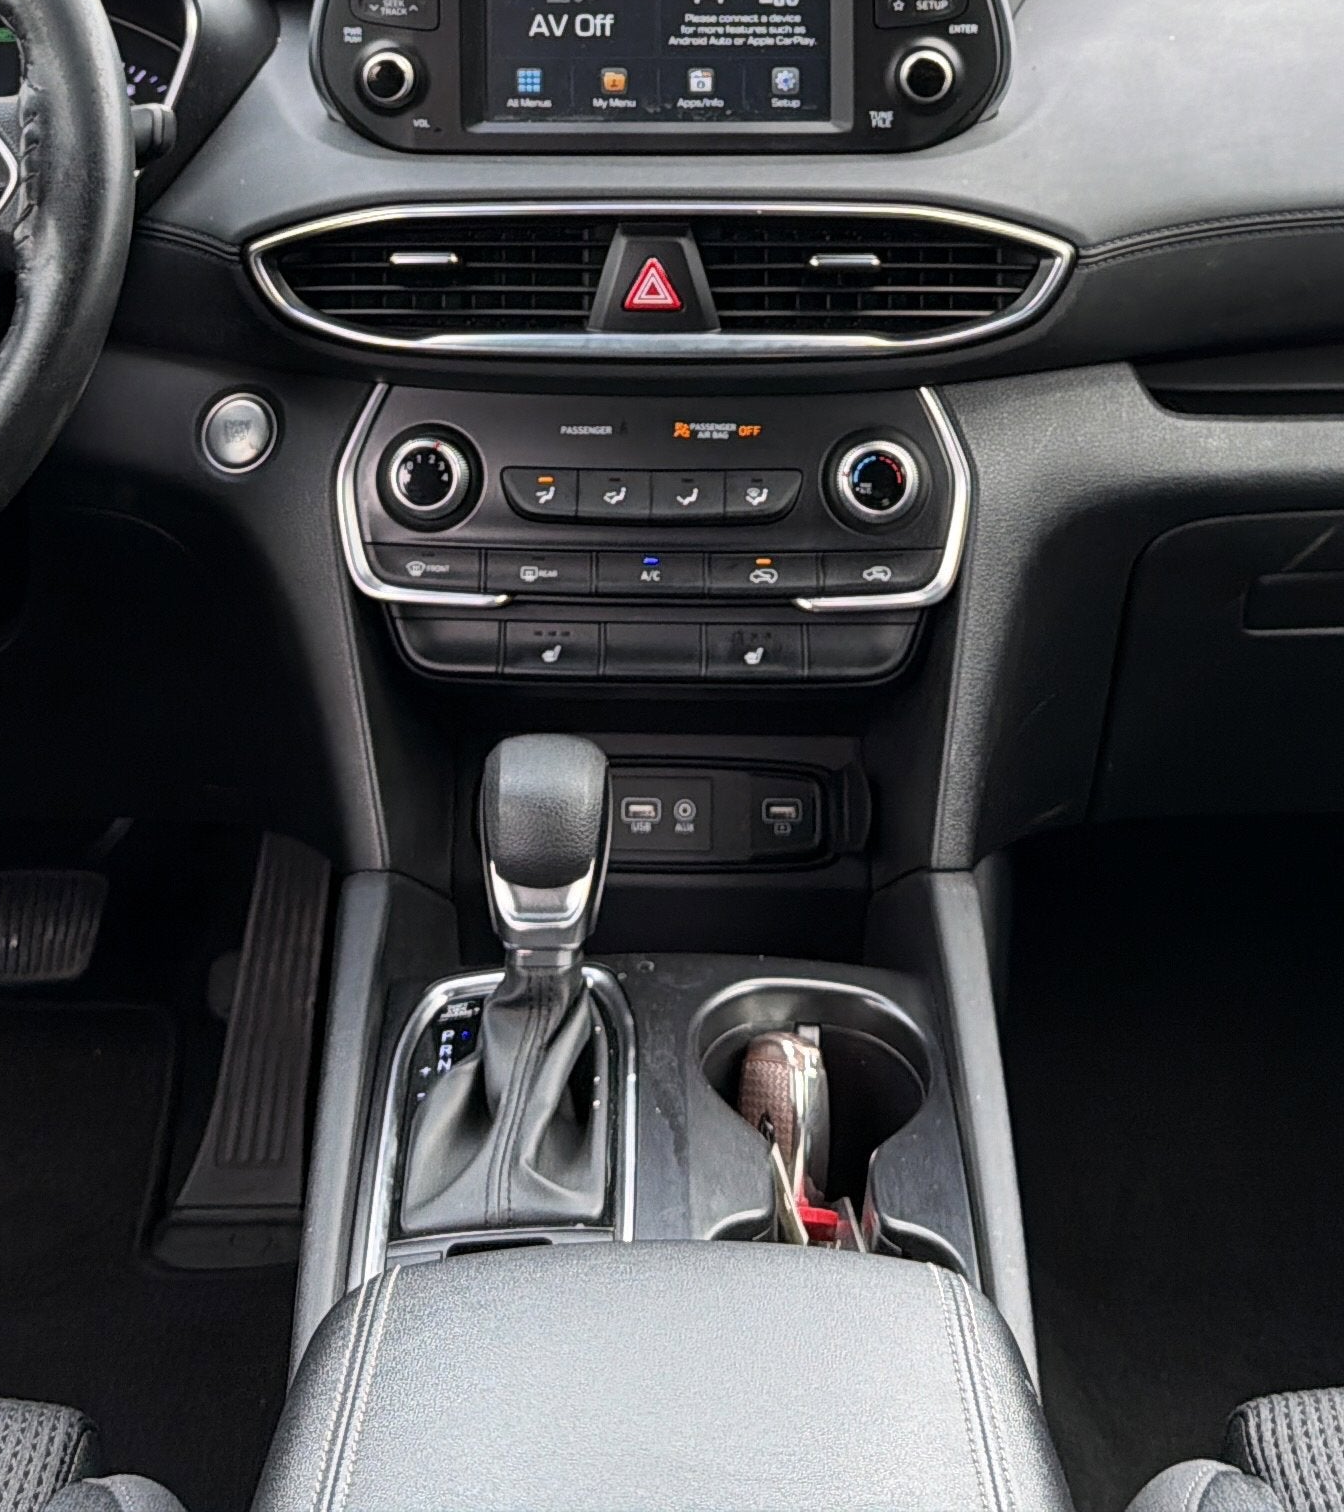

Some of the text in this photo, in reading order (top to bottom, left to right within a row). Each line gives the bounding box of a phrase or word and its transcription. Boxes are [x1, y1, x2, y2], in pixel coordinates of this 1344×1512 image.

[382, 0, 405, 8] SEEK
[915, 0, 949, 11] SETUP
[380, 7, 407, 16] TRACK
[684, 13, 801, 24] Please connect a device
[528, 13, 615, 37] AV Off
[680, 25, 806, 34] for more features such as
[948, 24, 979, 34] ENTER
[668, 36, 817, 47] Android Auto or Apple CarPlay.
[506, 98, 553, 108] All Menus
[592, 98, 637, 110] My Menu
[676, 98, 725, 109] Apps/Info
[771, 98, 801, 109] Setup
[413, 119, 430, 128] VOL
[560, 425, 613, 435] PASSENGER
[690, 423, 736, 431] PASSENGER
[738, 425, 761, 437] OFF
[697, 431, 729, 439] AIR BAG
[428, 454, 436, 464] 2
[438, 461, 446, 471] 3
[441, 472, 449, 482] 4
[426, 564, 450, 573] FRONT
[538, 570, 558, 578] REAR
[640, 570, 661, 582] A/C
[631, 822, 652, 833] USB
[674, 823, 695, 833] AUX
[441, 1030, 455, 1043] P
[439, 1044, 453, 1058] R
[437, 1058, 452, 1073] N
